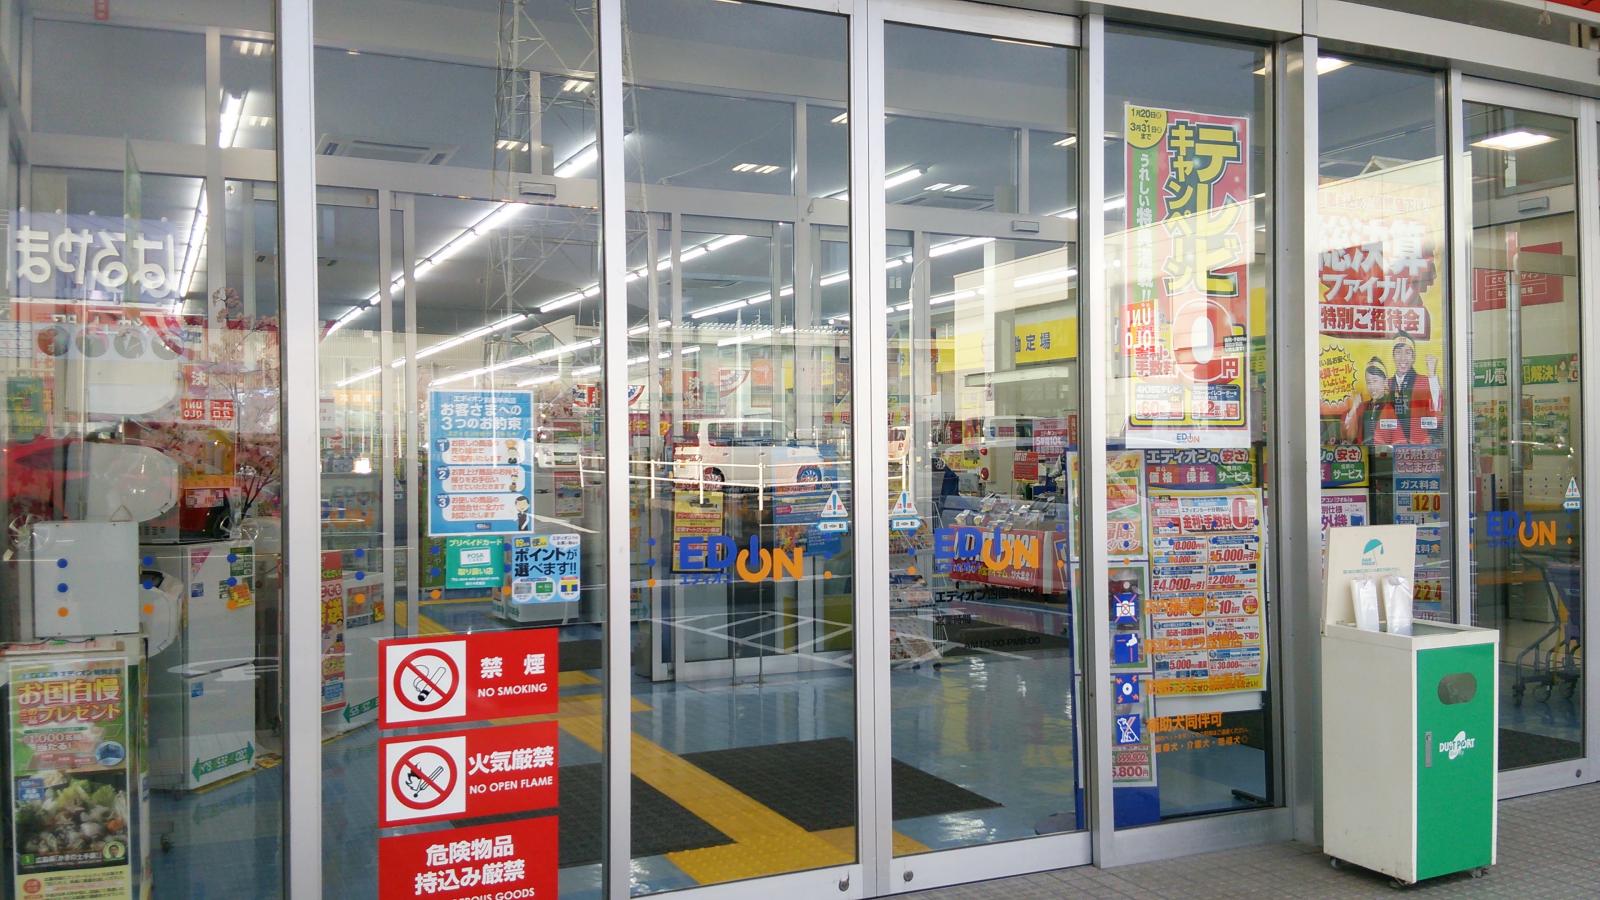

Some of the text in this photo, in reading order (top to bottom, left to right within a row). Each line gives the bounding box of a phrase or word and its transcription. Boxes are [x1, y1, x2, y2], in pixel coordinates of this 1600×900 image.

[1194, 126, 1242, 292] テレビ
[1322, 274, 1415, 304] ファイナル
[1320, 305, 1420, 331] 特別ご招待会
[440, 402, 522, 417] お客さまへの
[1218, 471, 1250, 482] サービス
[1333, 469, 1363, 480] サービス
[1400, 480, 1439, 489] ガス料金
[449, 538, 503, 547] プリペイドカード
[515, 547, 577, 562] ポイントが
[679, 534, 804, 583] EDION
[515, 562, 577, 577] 選べます!!
[480, 653, 546, 679] 禁 煙
[18, 676, 121, 705] お国自慢
[477, 682, 548, 698] NO SMOKING
[468, 745, 555, 776] 火気厳禁
[469, 775, 554, 795] NO OPEN FLAME
[426, 834, 515, 867] 危険物品
[414, 858, 526, 896] 持込み厳禁
[495, 887, 536, 900] GOODS
